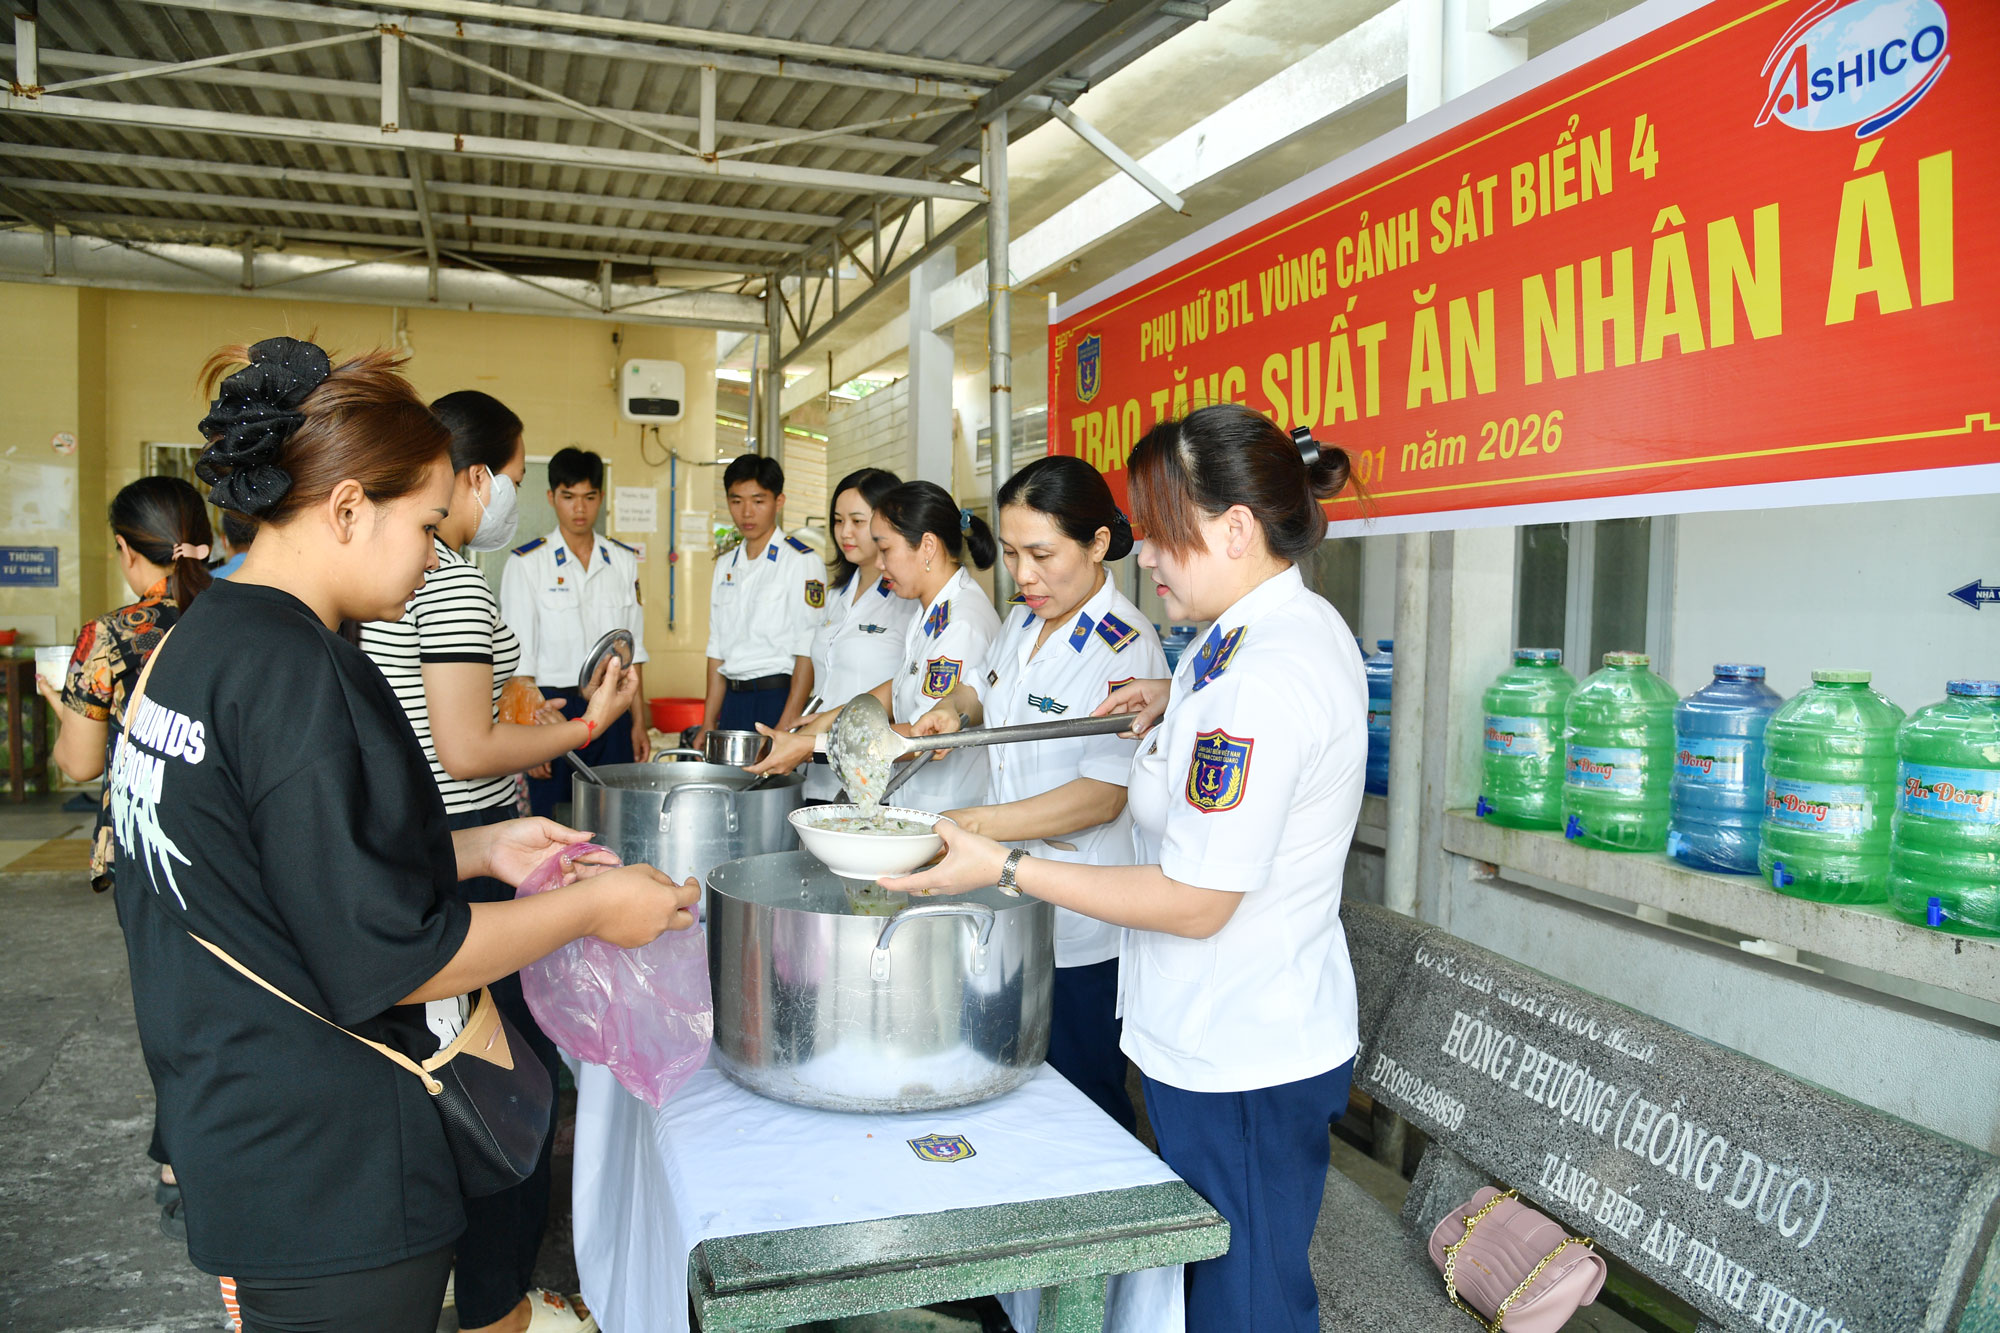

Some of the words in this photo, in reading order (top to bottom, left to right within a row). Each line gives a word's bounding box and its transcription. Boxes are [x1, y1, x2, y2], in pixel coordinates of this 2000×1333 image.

[1754, 25, 1945, 128] ASHICO
[1140, 310, 1176, 362] PHỤ
[1181, 288, 1211, 347] NỮ
[1215, 279, 1254, 335] BTL
[1259, 253, 1328, 317] VÙNG
[1336, 207, 1419, 289] CẢNH
[1430, 173, 1498, 254] SÁT
[1511, 114, 1613, 227] BIỂN
[1629, 113, 1659, 181] 4
[1071, 398, 1141, 475] TRAO
[1261, 295, 1387, 435] SUẤT
[1406, 283, 1497, 410] ĂN
[1522, 202, 1783, 386] NHÂN
[1825, 136, 1955, 326] ÁI
[1357, 446, 1387, 485] 01
[1401, 429, 1467, 473] năm
[1477, 410, 1565, 463] 2026
[1976, 589, 1995, 599] NHÀ
[1595, 1183, 1645, 1240] BẾP
[1640, 1207, 1686, 1267] ĂN
[1682, 1237, 1755, 1311] TÌNH
